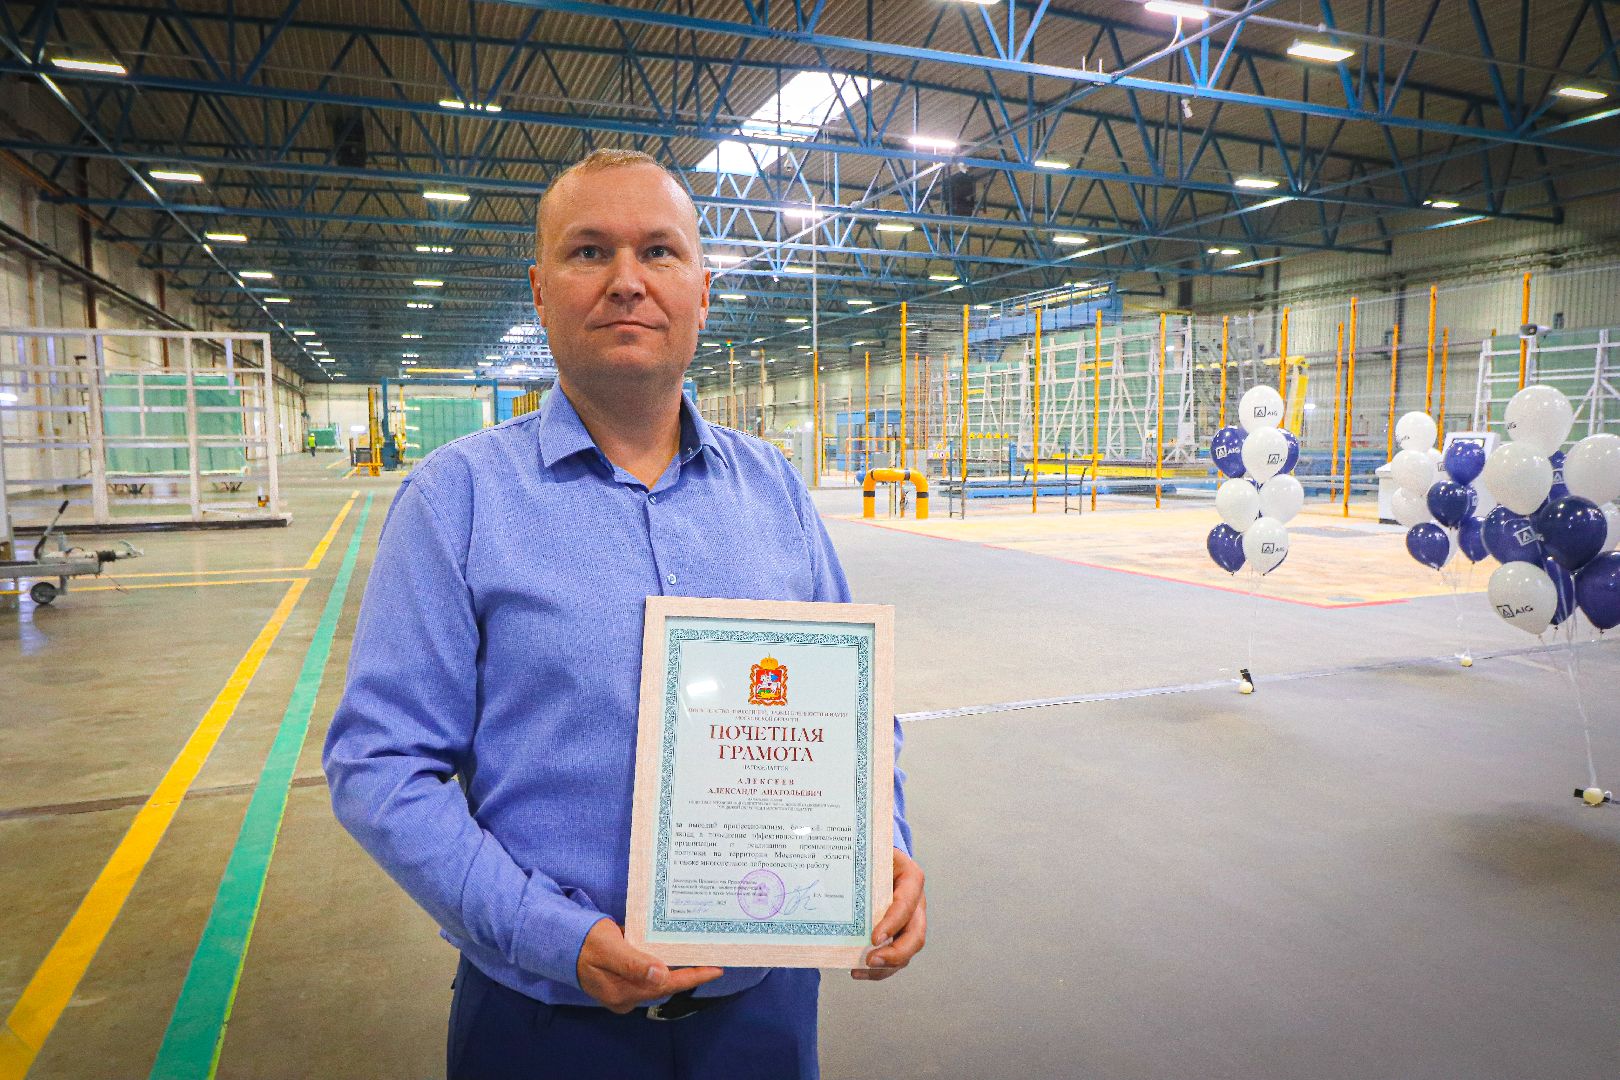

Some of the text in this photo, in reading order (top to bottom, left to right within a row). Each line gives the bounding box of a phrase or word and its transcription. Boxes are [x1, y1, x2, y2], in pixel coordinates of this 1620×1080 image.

[1515, 605, 1534, 615] AIG
[709, 724, 825, 743] ПОЧЕТНАЯ
[718, 744, 814, 762] ГРАМОТА
[737, 777, 795, 786] АЛЕКСЕЕВ
[707, 787, 823, 797] АЛЕКСАНДР АНАТОЛЬЕВИЧ
